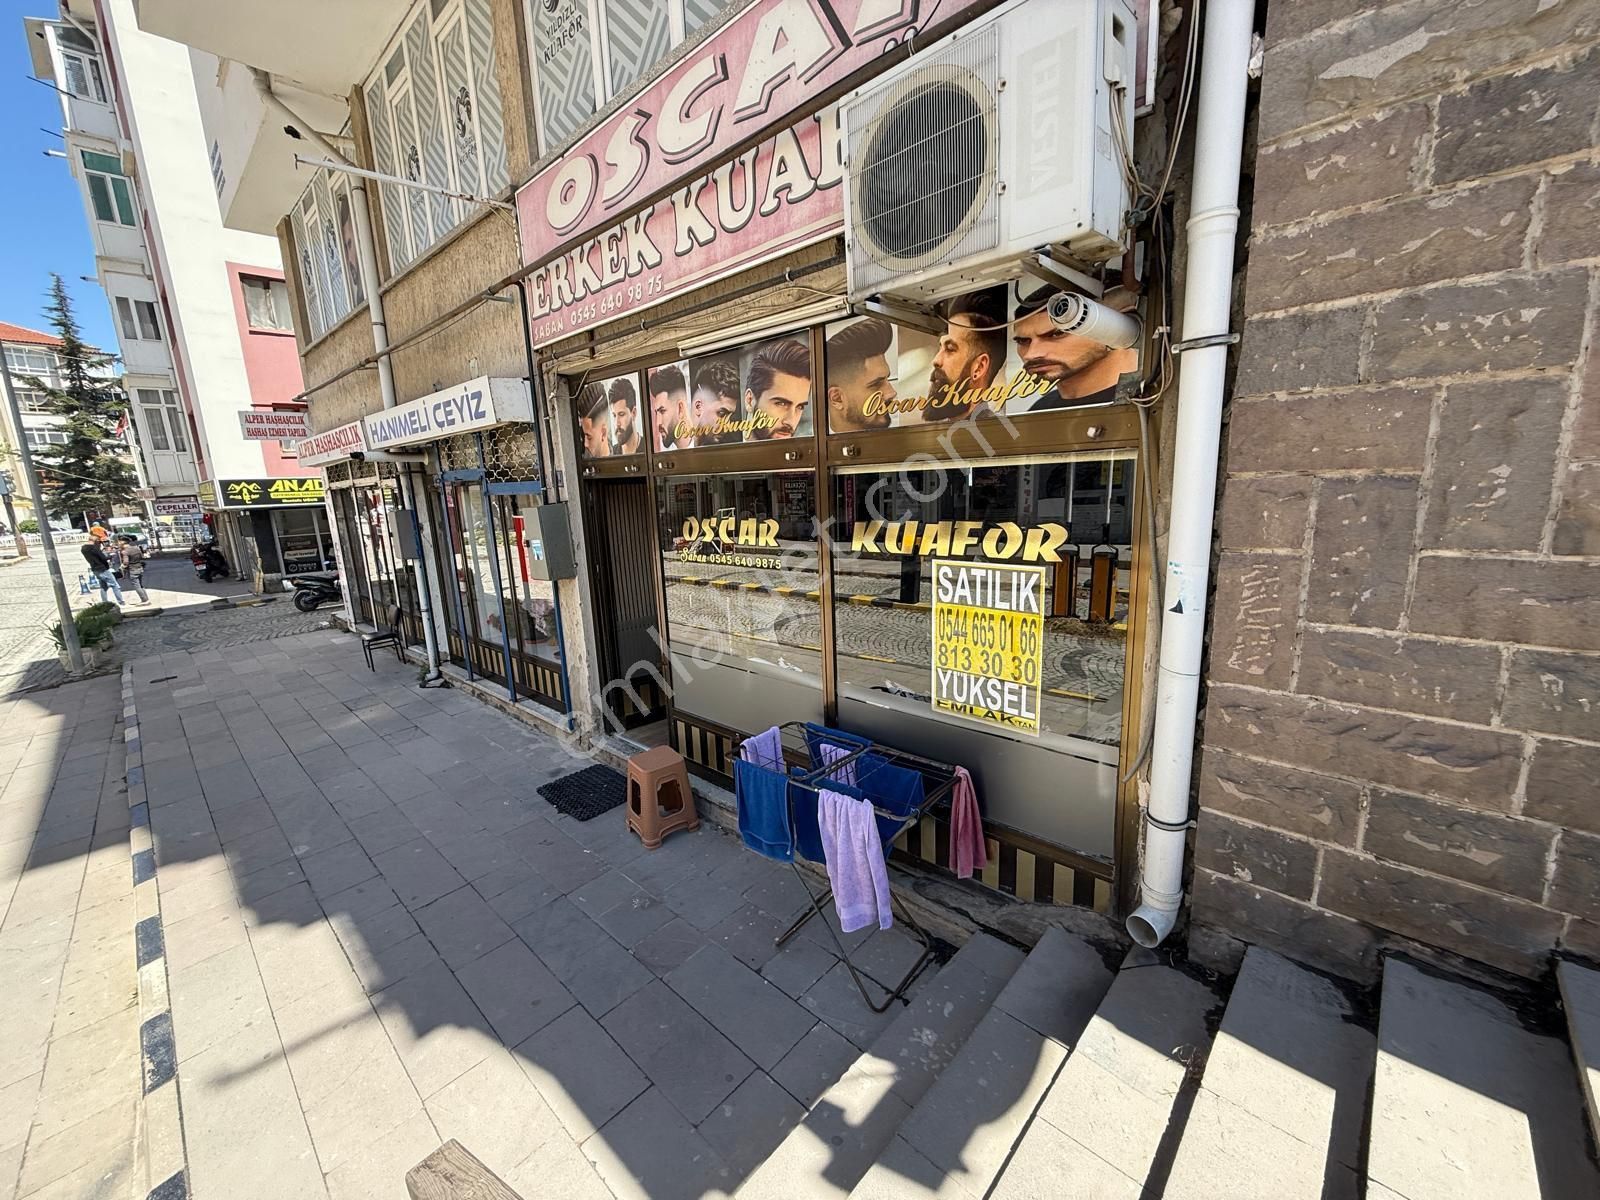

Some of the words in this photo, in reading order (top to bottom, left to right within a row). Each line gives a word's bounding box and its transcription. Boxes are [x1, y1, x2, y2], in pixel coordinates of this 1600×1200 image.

[543, 14, 583, 64] KUAFÖR
[528, 203, 662, 320] ERKEK
[570, 303, 597, 326] 0545
[600, 292, 623, 315] 640
[627, 283, 642, 303] 98
[648, 274, 663, 297] 75
[370, 400, 431, 444] HANIMELİ
[433, 386, 487, 432] ÇEYİZ
[863, 391, 930, 418] Oscar
[931, 368, 1060, 411] Kuaför
[245, 414, 265, 424] ALPER
[674, 420, 714, 440] Oscar
[712, 408, 781, 438] Kuaför
[298, 440, 316, 459] ALPER
[156, 504, 198, 513] ÇEPELLER
[682, 516, 781, 547] OSCAR
[709, 554, 733, 565] 0545
[735, 556, 754, 568] 640
[755, 558, 782, 570] 9875
[938, 565, 1041, 614] SATILIK
[938, 607, 968, 645] 0544
[972, 611, 996, 650] 665
[999, 615, 1015, 653] 01
[1019, 617, 1038, 657] 66
[938, 643, 972, 671] 813
[979, 650, 1003, 677] 30
[1010, 655, 1037, 684] 30
[937, 667, 1037, 720] YÜKSEL
